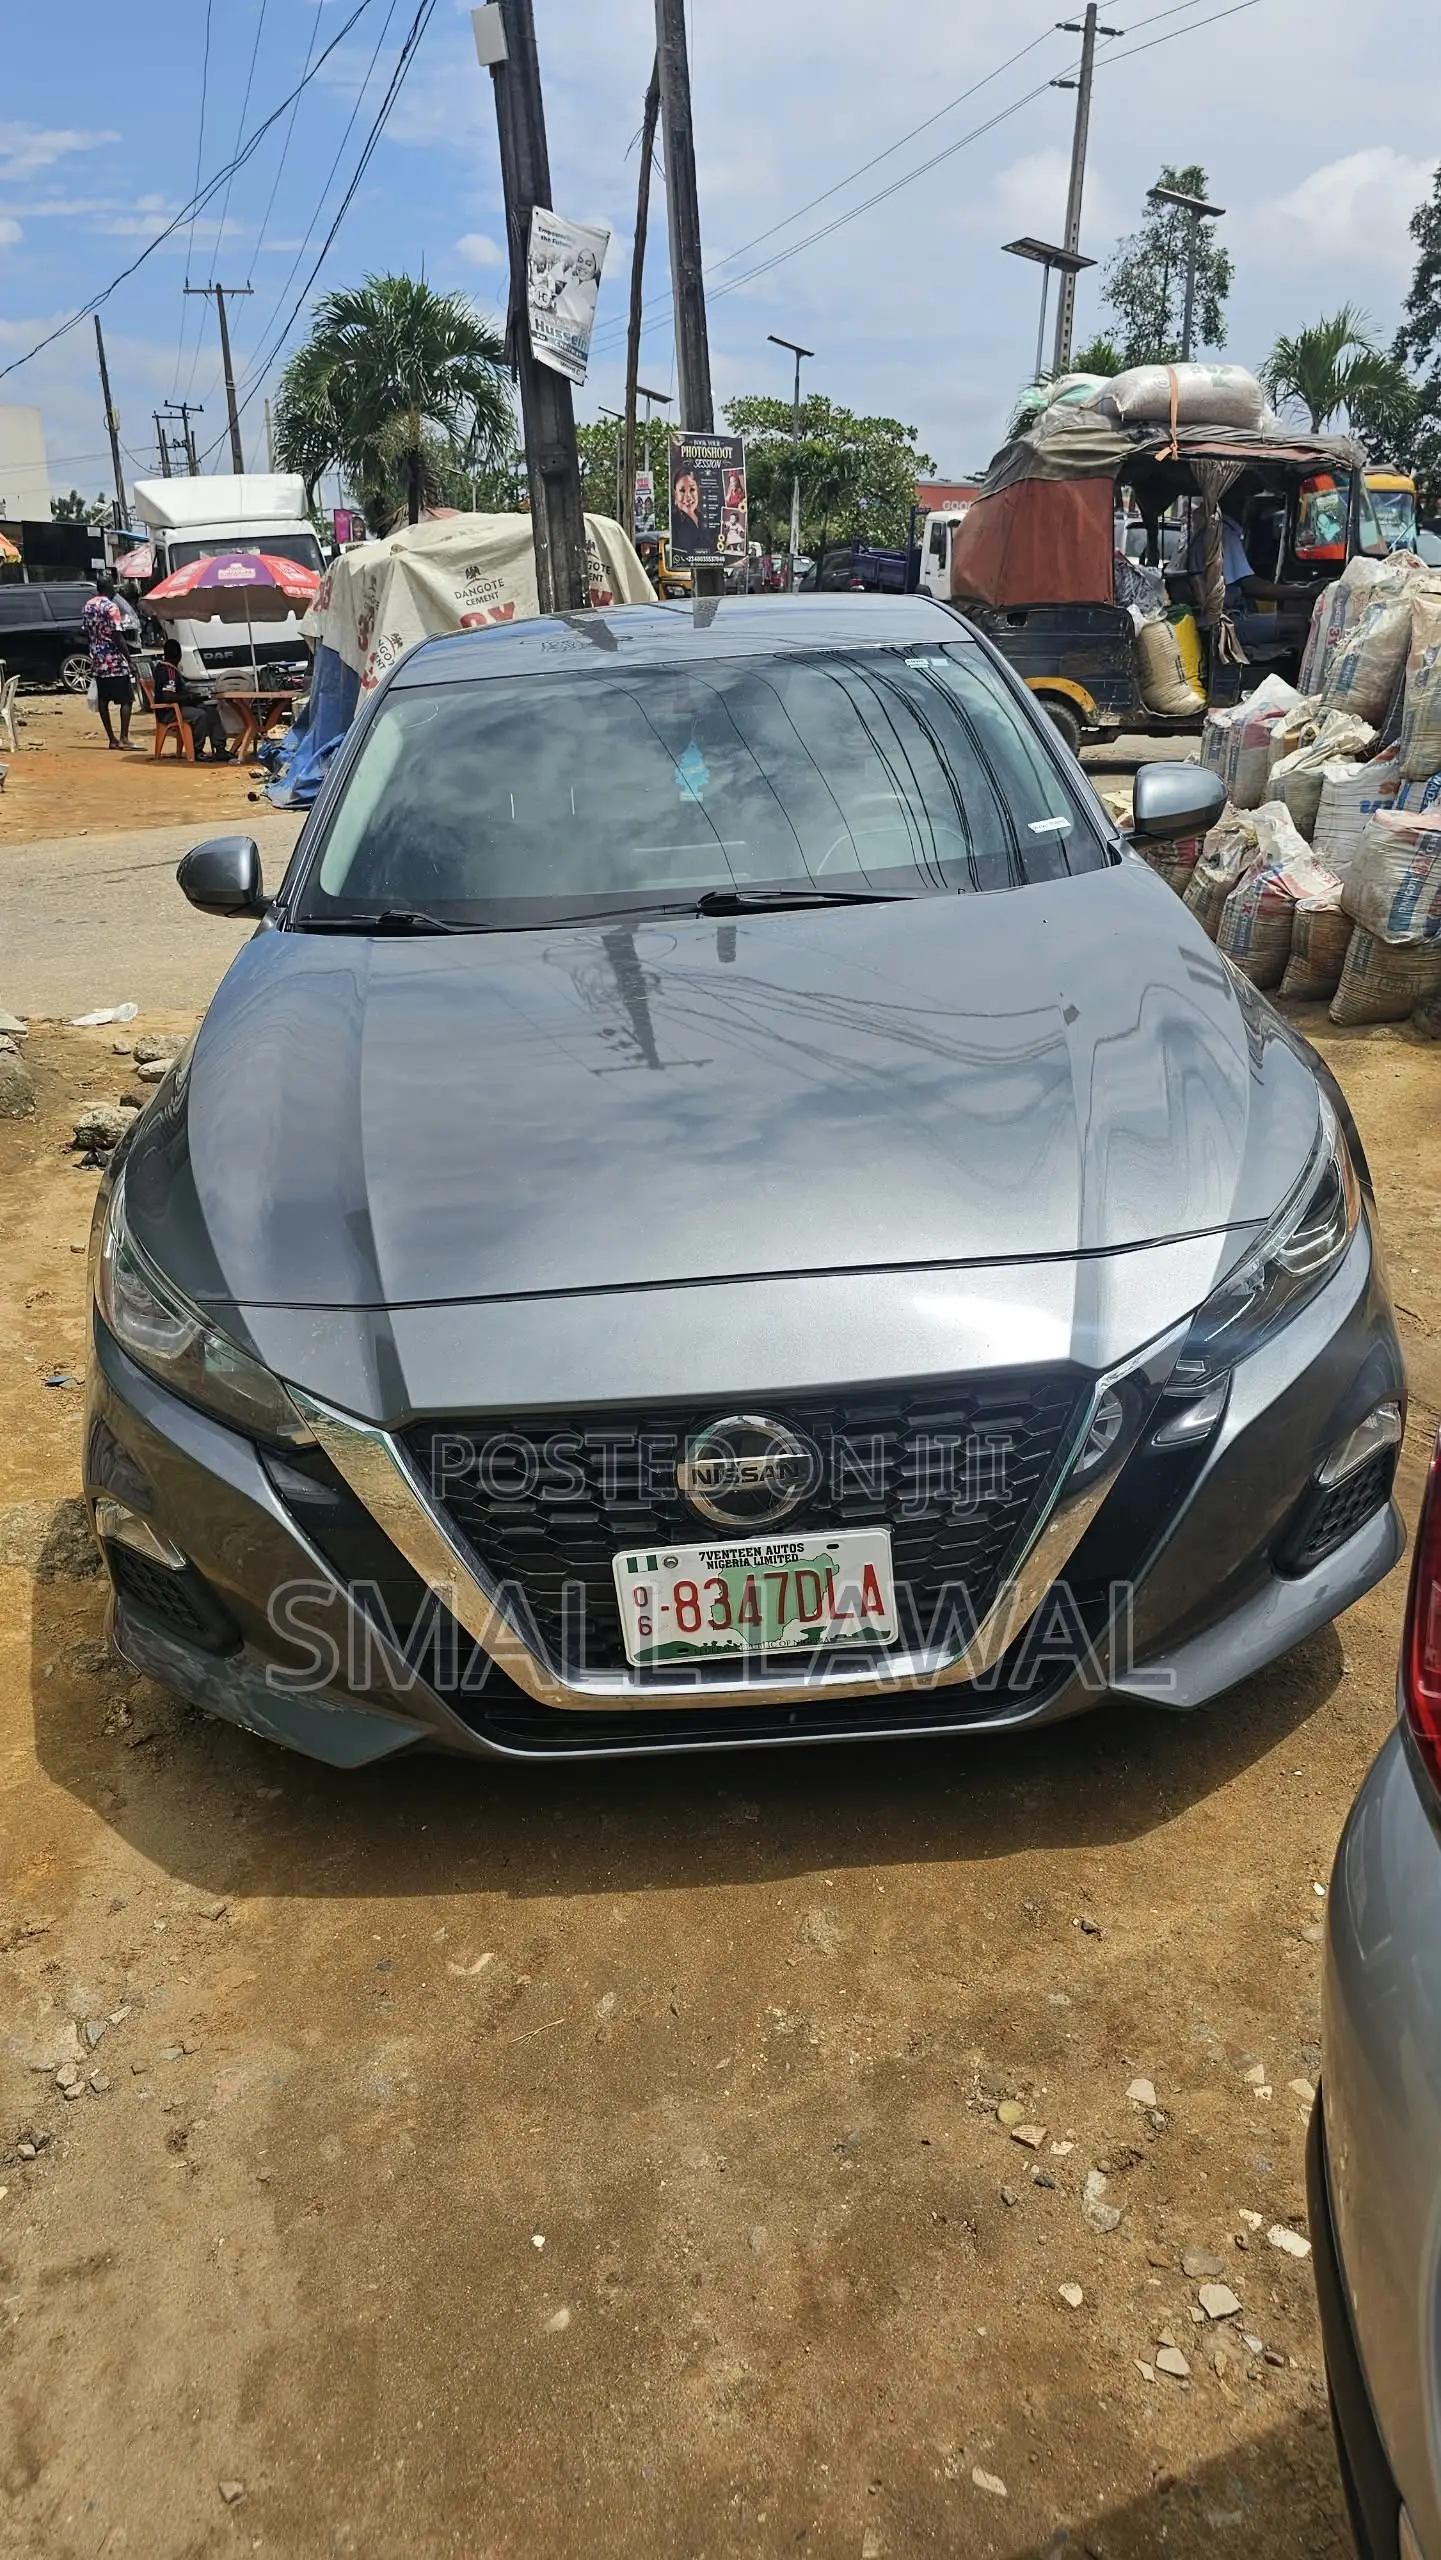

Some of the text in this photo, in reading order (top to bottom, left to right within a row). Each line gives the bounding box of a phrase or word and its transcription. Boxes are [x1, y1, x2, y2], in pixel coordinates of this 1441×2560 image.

[535, 318, 588, 351] Hussein
[681, 446, 733, 459] PHOTOSHOOT
[693, 459, 722, 469] SESSION
[587, 561, 611, 575] GOTE
[454, 578, 505, 600] DANGOTE
[466, 591, 499, 607] CEMENT
[203, 650, 234, 660] DAF
[690, 1462, 799, 1486] NISSAN
[698, 1543, 805, 1562] 7VENTEEN AUTOS
[706, 1554, 799, 1570] NIGERIA LIMITED
